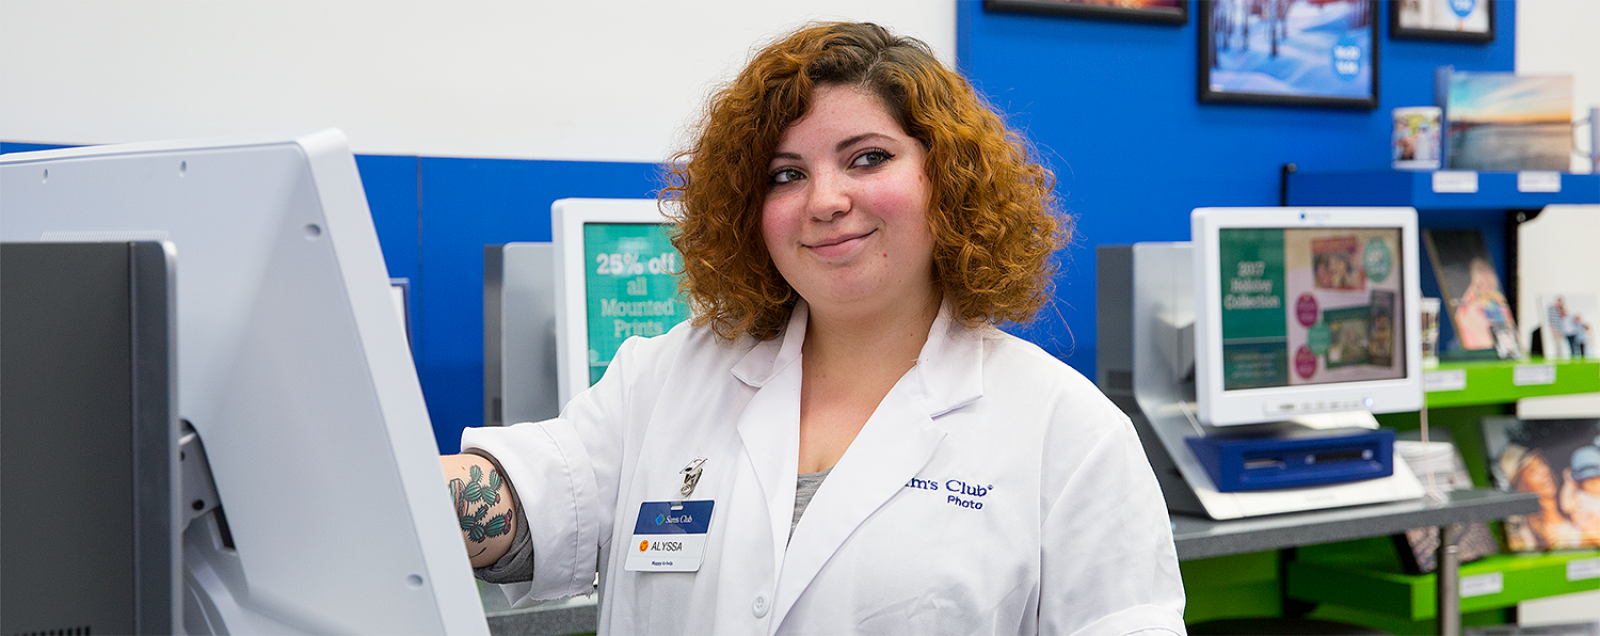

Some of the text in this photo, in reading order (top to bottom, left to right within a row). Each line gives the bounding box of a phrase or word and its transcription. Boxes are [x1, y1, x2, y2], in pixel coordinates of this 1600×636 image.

[596, 252, 675, 275] 25% off
[627, 276, 647, 295] all
[601, 299, 674, 316] Mounted
[1224, 294, 1281, 310] Collection
[614, 319, 663, 337] Prints
[905, 478, 938, 490] m's
[947, 495, 983, 509] Photo
[651, 542, 683, 551] ALYSSA
